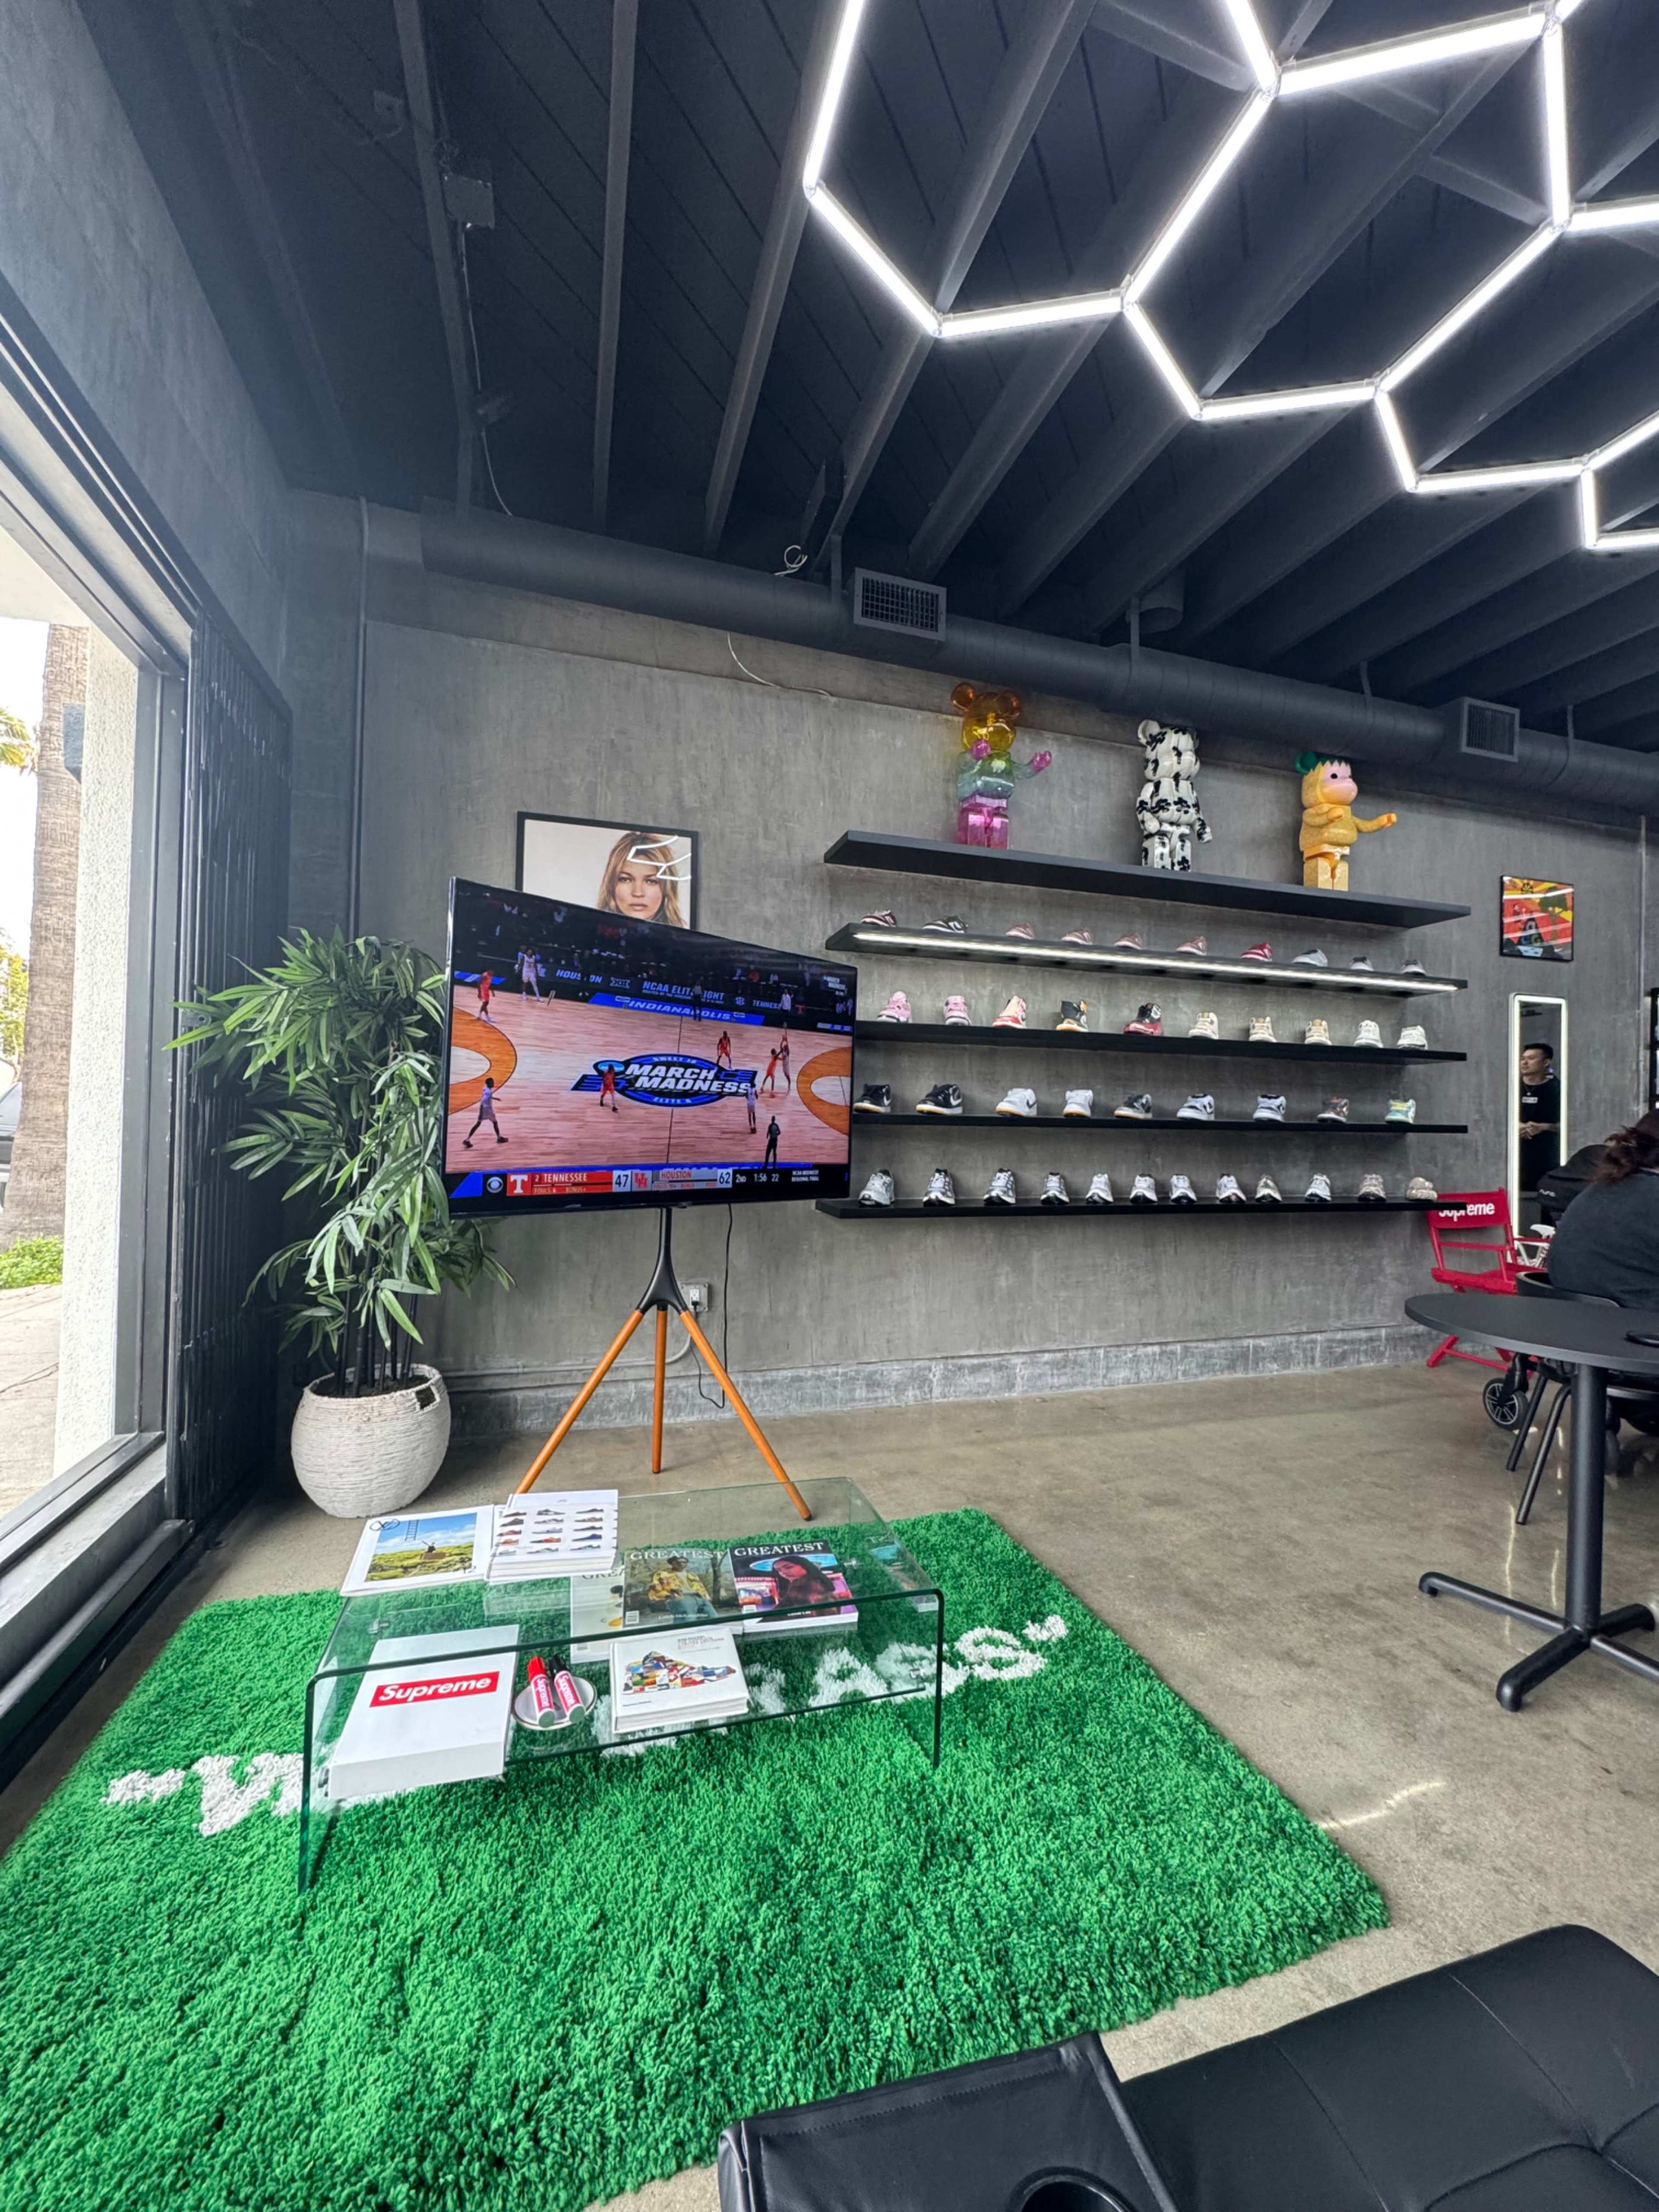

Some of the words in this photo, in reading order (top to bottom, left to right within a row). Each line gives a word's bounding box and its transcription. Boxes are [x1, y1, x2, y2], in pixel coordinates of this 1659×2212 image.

[643, 981, 669, 993] NCAA
[626, 1064, 716, 1080] MARCH
[635, 1077, 752, 1093] MADNESS
[543, 1173, 588, 1183] TENNESSEE
[615, 1174, 629, 1188] 47
[661, 1170, 692, 1179] HOUSTON
[719, 1172, 731, 1184] 62
[754, 1173, 767, 1182] 1:56
[771, 1173, 779, 1182] 22
[630, 1549, 725, 1560] GREATEST
[734, 1541, 824, 1556] GREATEST
[378, 1676, 492, 1702] Supreme
[535, 1678, 550, 1708] Supreme
[558, 1675, 575, 1707] Supreme
